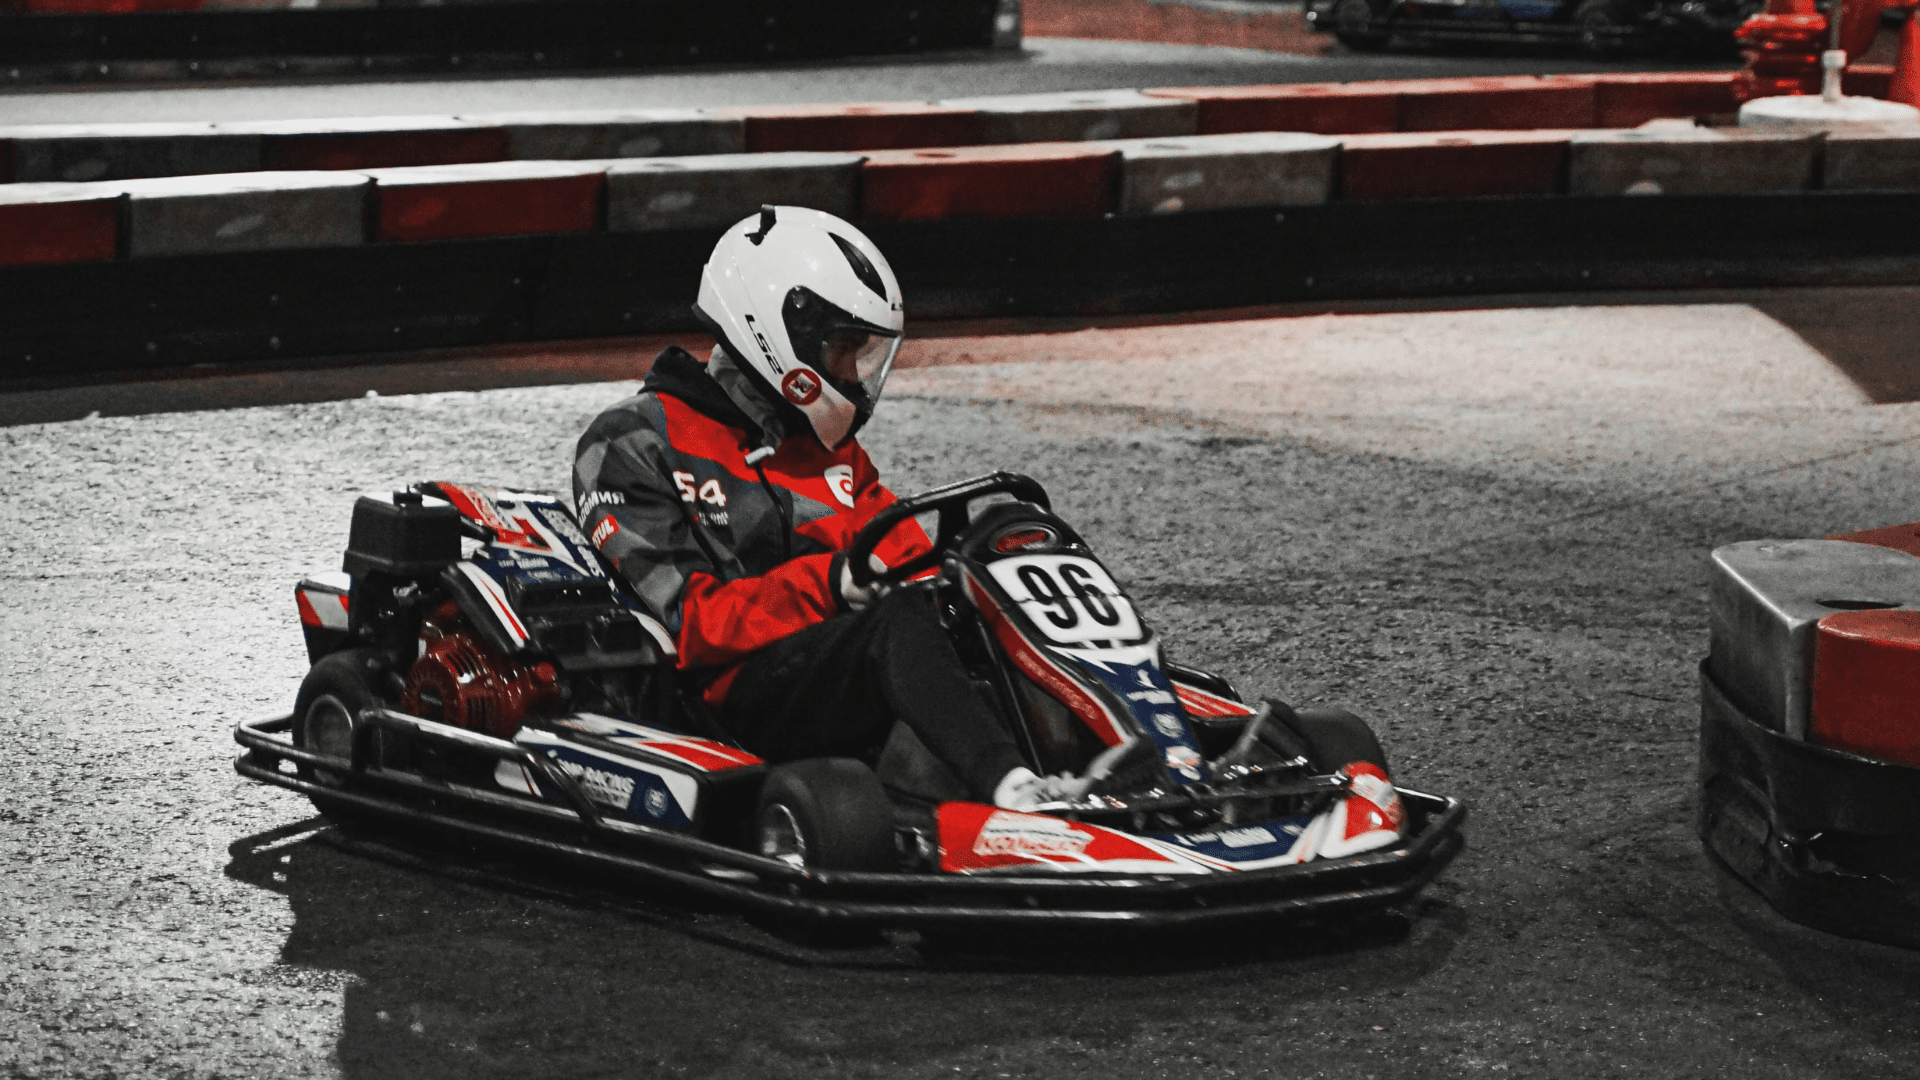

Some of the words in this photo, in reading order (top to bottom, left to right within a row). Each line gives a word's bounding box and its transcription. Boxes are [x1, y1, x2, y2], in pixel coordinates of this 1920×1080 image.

[745, 314, 784, 375] LS2
[673, 469, 727, 507] 54
[1017, 563, 1120, 629] 96
